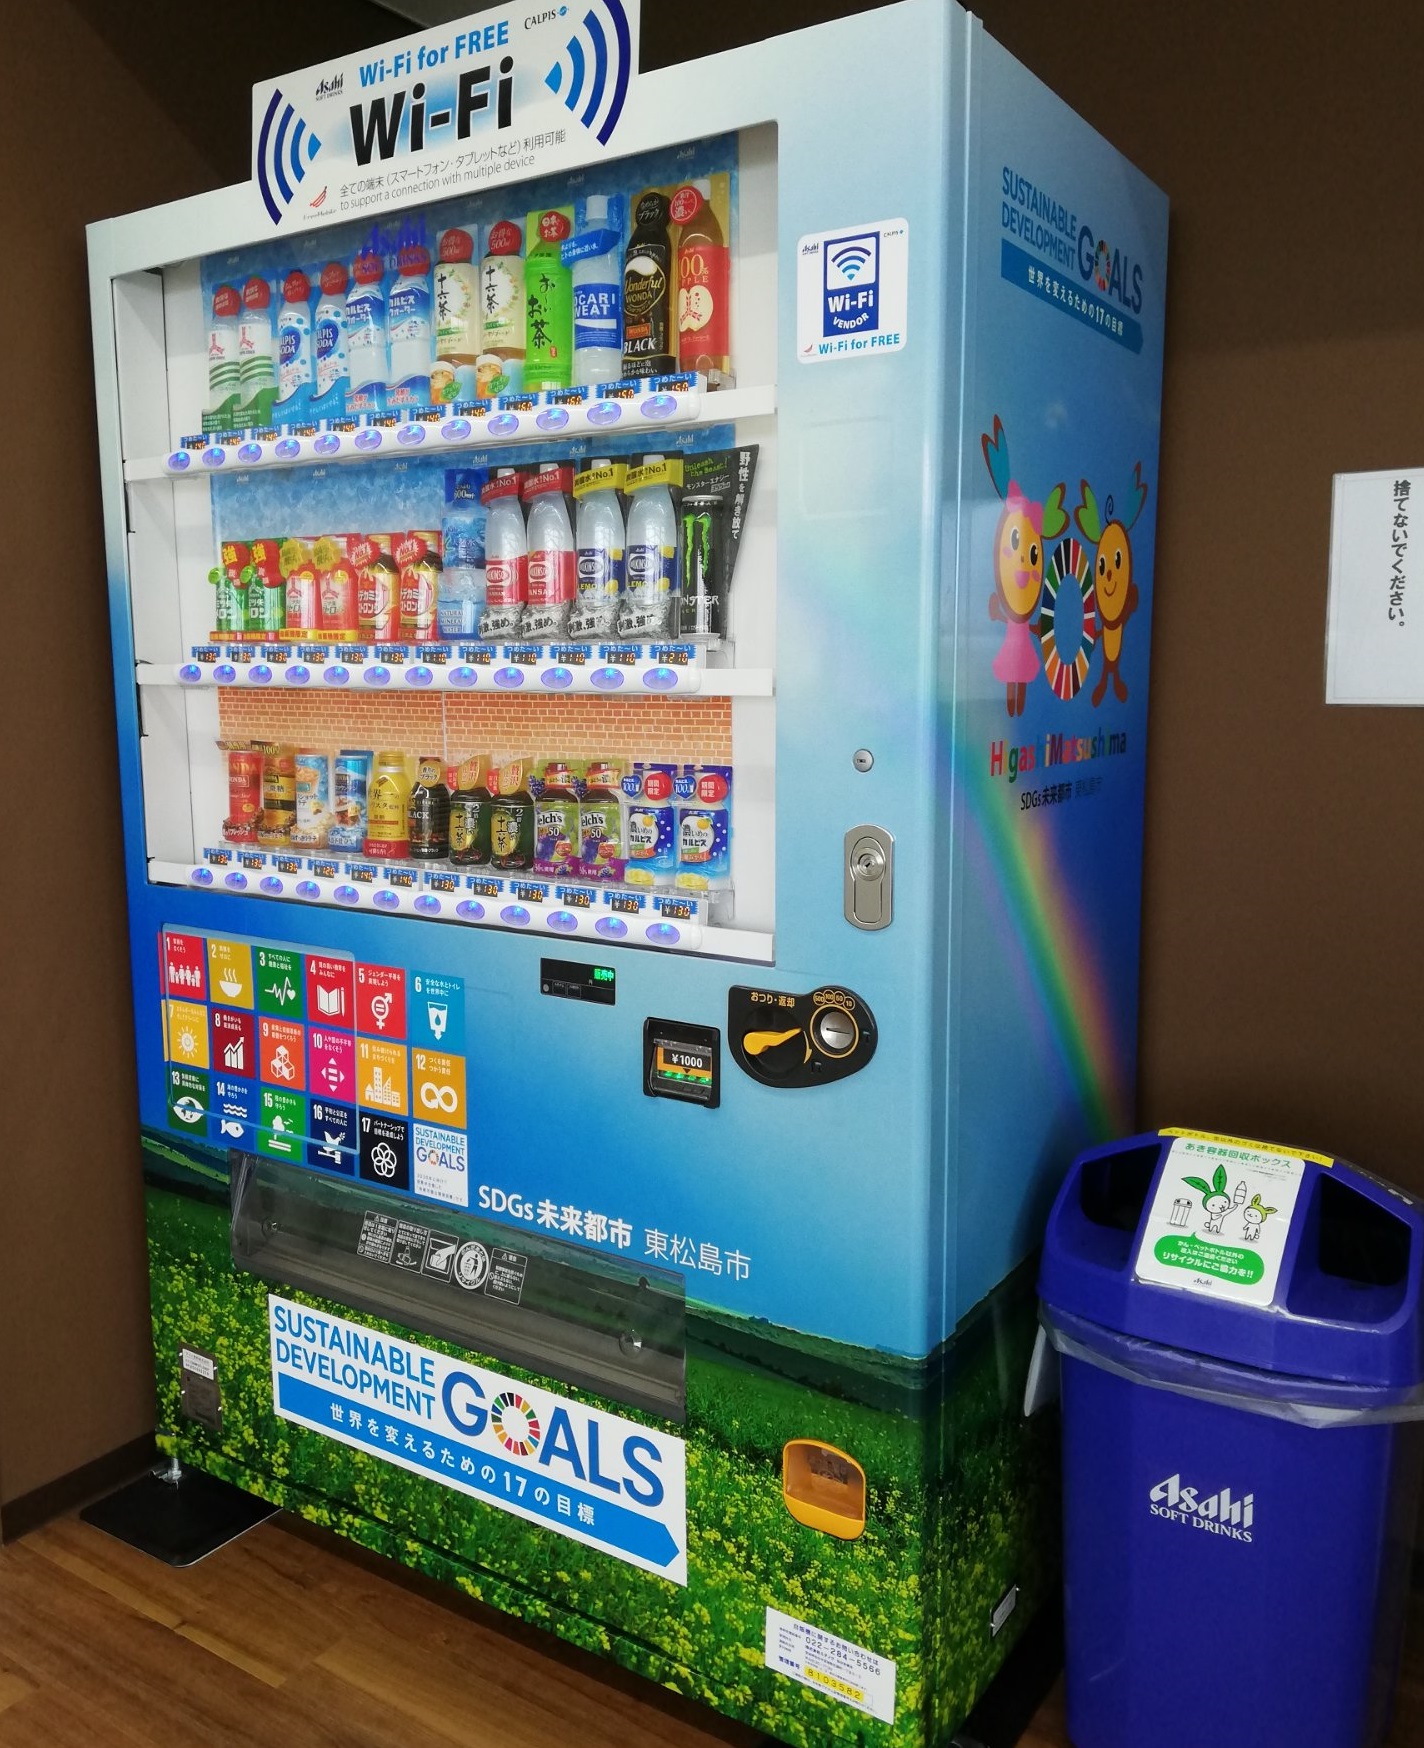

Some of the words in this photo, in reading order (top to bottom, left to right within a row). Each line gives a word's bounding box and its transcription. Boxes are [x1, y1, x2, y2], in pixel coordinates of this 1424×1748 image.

[524, 9, 556, 30] CALPIS
[360, 54, 412, 88] Wi-Fi
[417, 44, 449, 73] for
[455, 20, 509, 59] FREE
[316, 72, 343, 96] Asahi
[350, 55, 514, 167] Wi-Fi
[340, 201, 350, 210] to
[350, 192, 383, 210] support
[384, 190, 390, 200] a
[392, 178, 440, 198] connection
[442, 169, 462, 185] with
[464, 162, 501, 181] multiple
[504, 154, 535, 170] device
[1002, 166, 1076, 241] SUSTAINABLE
[1002, 202, 1075, 270] DEVELOPMENT
[1078, 225, 1143, 315] GOALS
[682, 276, 708, 286] PPLE
[438, 273, 451, 320] 十六茶
[485, 266, 499, 314] 十六茶
[828, 290, 874, 313] Wi-Fi
[575, 304, 610, 318] WEAT
[833, 312, 870, 329] VENDOR
[818, 340, 848, 354] Wi-Fi
[851, 339, 868, 350] for
[872, 334, 900, 347] FREE
[1388, 480, 1412, 628] 捨てないでください。
[681, 595, 719, 606] NSTER
[990, 727, 1126, 783] HigasiMatsushima
[648, 780, 659, 788] 期間
[648, 788, 660, 796] 限定
[701, 790, 714, 798] 限定
[408, 811, 429, 819] LACK
[538, 813, 562, 825] elch's
[582, 814, 604, 826] elch's
[456, 814, 464, 846] 十六茶
[496, 816, 507, 852] 十六茶
[683, 838, 706, 847] カルピス
[212, 944, 216, 958] 2
[259, 952, 266, 966] 3
[310, 960, 316, 975] 4
[358, 968, 365, 983] 5
[594, 968, 614, 982] 販売中
[415, 977, 422, 992] 6
[750, 992, 796, 1008] おつり・返却
[215, 1013, 220, 1027] 8
[263, 1022, 268, 1037] 9
[313, 1033, 322, 1048] 10
[361, 1043, 368, 1059] 11
[416, 1054, 426, 1070] 12
[672, 1054, 702, 1068] ¥1000
[172, 1071, 180, 1085] 13
[217, 1082, 226, 1096] 14
[264, 1093, 272, 1108] 15
[313, 1104, 322, 1120] 16
[362, 1117, 370, 1132] 17
[416, 1127, 464, 1146] SUSTAINABLE
[416, 1137, 464, 1156] DEVELOPMENT
[416, 1146, 465, 1172] GOALS
[1185, 1143, 1291, 1168] あき容器回収ボックス
[478, 1185, 632, 1249] SDGs未来都市
[644, 1228, 752, 1280] 東松島市
[274, 1305, 435, 1388] SUSTAINABLE
[276, 1338, 435, 1420] DEVELOPMENT
[442, 1370, 664, 1507] GOALS
[330, 1402, 595, 1526] 世界を変えるための17の目標
[1150, 1474, 1254, 1528] Asahi
[1150, 1504, 1188, 1524] SOFT
[1192, 1516, 1252, 1542] DRINKS
[807, 1667, 862, 1699] 8103582
